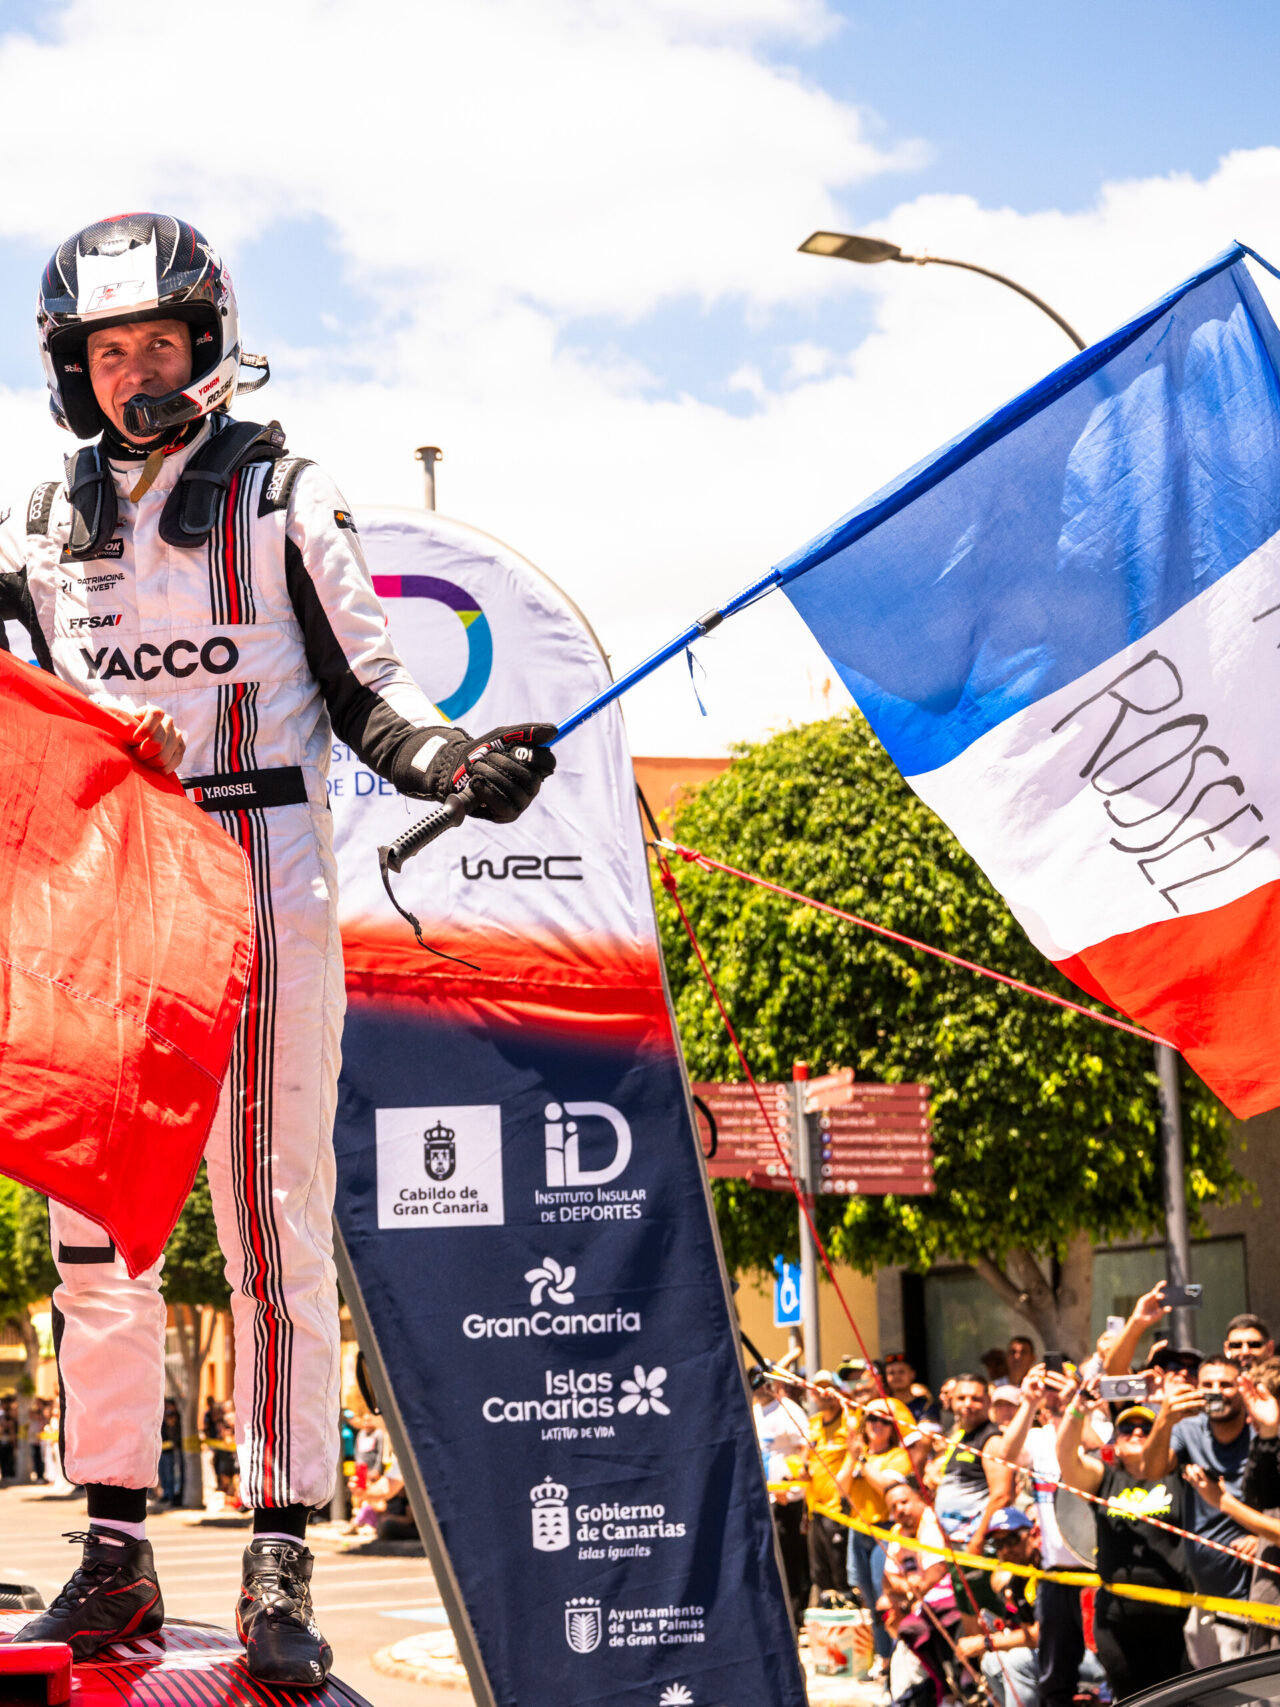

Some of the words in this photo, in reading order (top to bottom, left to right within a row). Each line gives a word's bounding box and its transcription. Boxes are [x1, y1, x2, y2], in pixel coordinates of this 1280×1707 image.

[198, 376, 220, 396] YOHAN
[77, 573, 125, 585] PATRIMOINE
[69, 615, 115, 630] FFSA
[80, 636, 240, 681] YACCO
[1051, 649, 1270, 914] ROSSEL
[203, 782, 257, 800] Y.ROSSEL
[461, 855, 584, 880] WRC
[399, 1187, 456, 1202] Cabildo
[459, 1186, 478, 1200] de
[393, 1201, 429, 1216] Gran
[432, 1199, 489, 1215] Canaria
[541, 1211, 557, 1223] DE
[559, 1204, 642, 1223] DEPORTES
[462, 1307, 641, 1340] GranCanaria
[545, 1369, 614, 1397] Islas
[482, 1393, 614, 1424] Canarias
[541, 1426, 579, 1441] LATITUD
[580, 1427, 593, 1439] DE
[593, 1425, 615, 1438] VIDA
[575, 1502, 666, 1522] Gobierno
[576, 1524, 600, 1542] de
[602, 1521, 686, 1540] Canarias
[578, 1545, 606, 1560] islas
[607, 1544, 651, 1561] iguales
[608, 1605, 704, 1623] Ayuntamiento
[608, 1621, 625, 1633] de
[631, 1619, 653, 1632] Las
[659, 1617, 705, 1631] Palmas
[608, 1635, 625, 1647] de
[626, 1633, 657, 1647] Gran
[659, 1631, 705, 1645] Canaria
